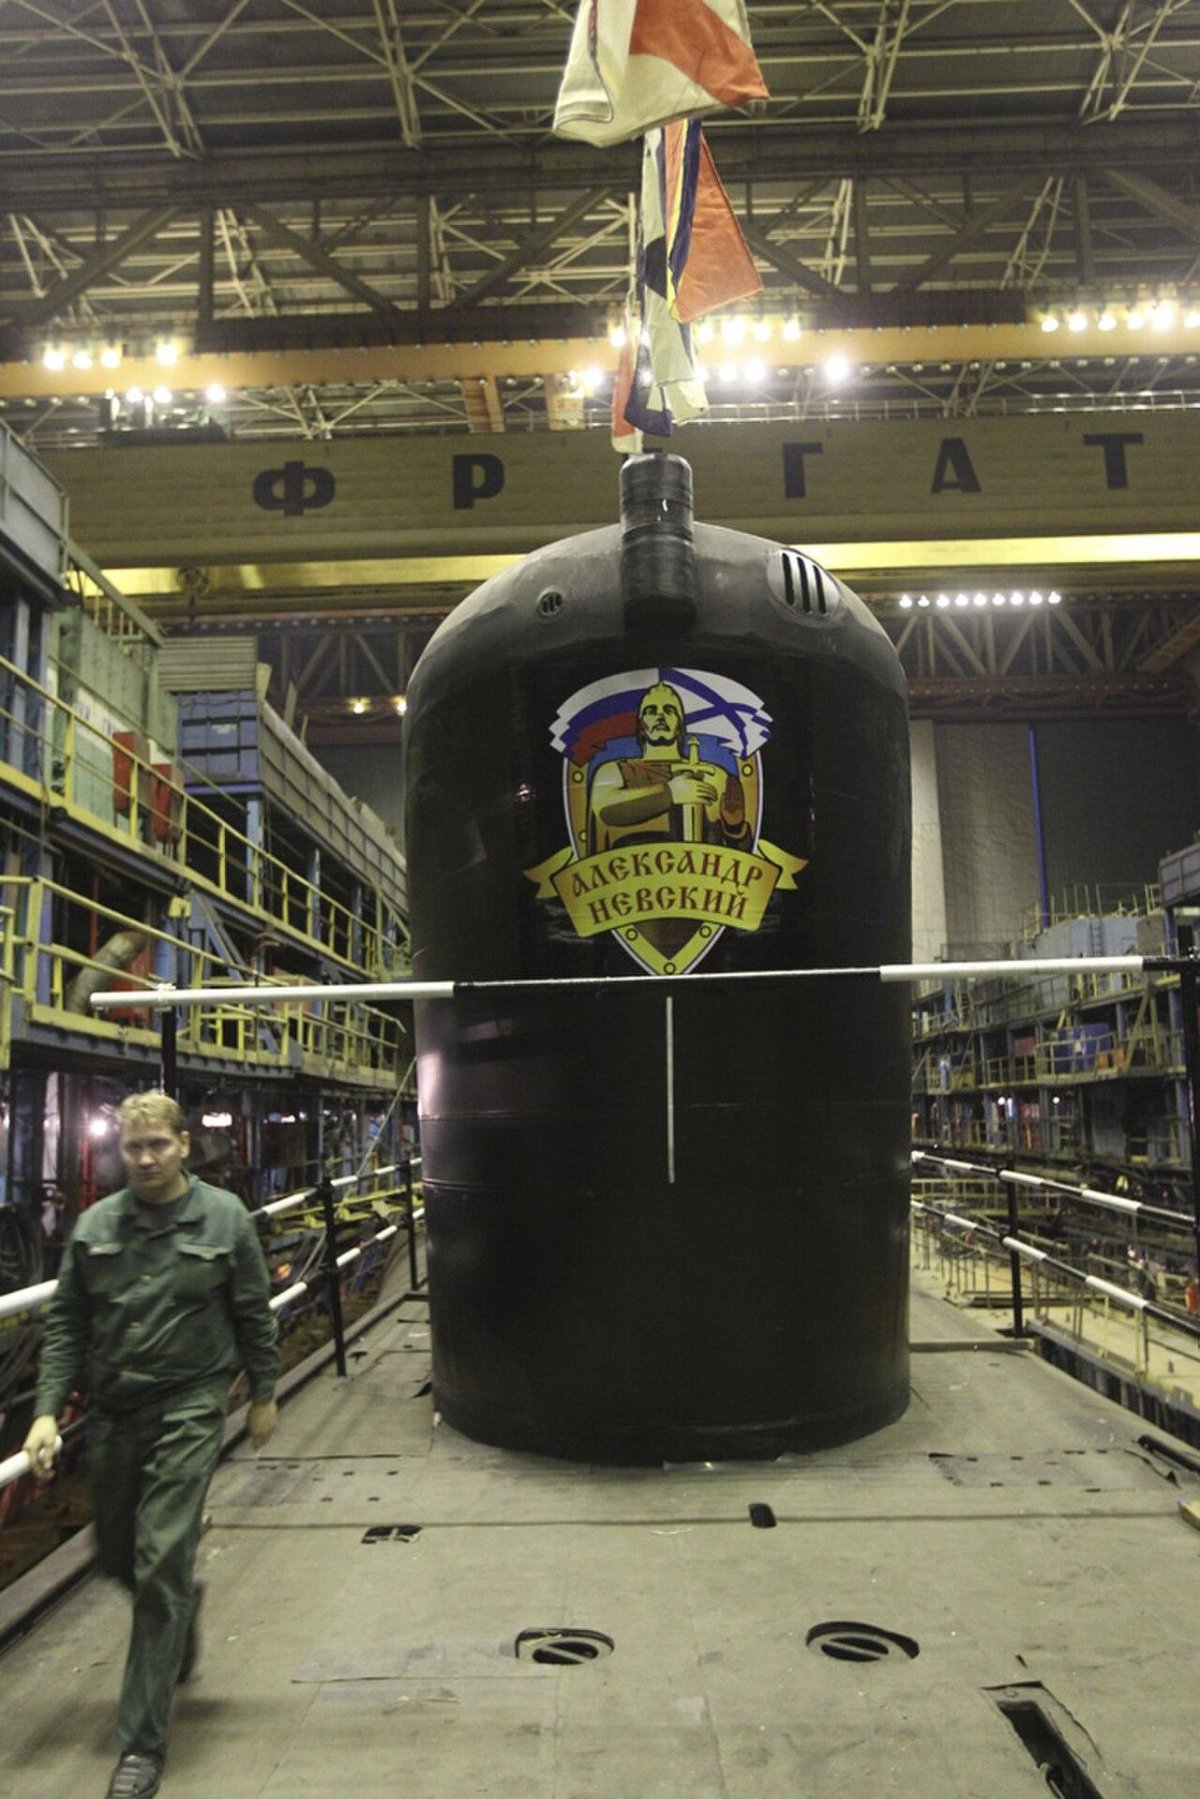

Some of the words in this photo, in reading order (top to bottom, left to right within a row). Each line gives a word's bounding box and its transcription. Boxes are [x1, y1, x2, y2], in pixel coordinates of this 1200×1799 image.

[252, 433, 1144, 516] ФРГАТ
[572, 849, 763, 898] АЛЕКСАНДР
[588, 886, 747, 925] НЕВСКИЙ
